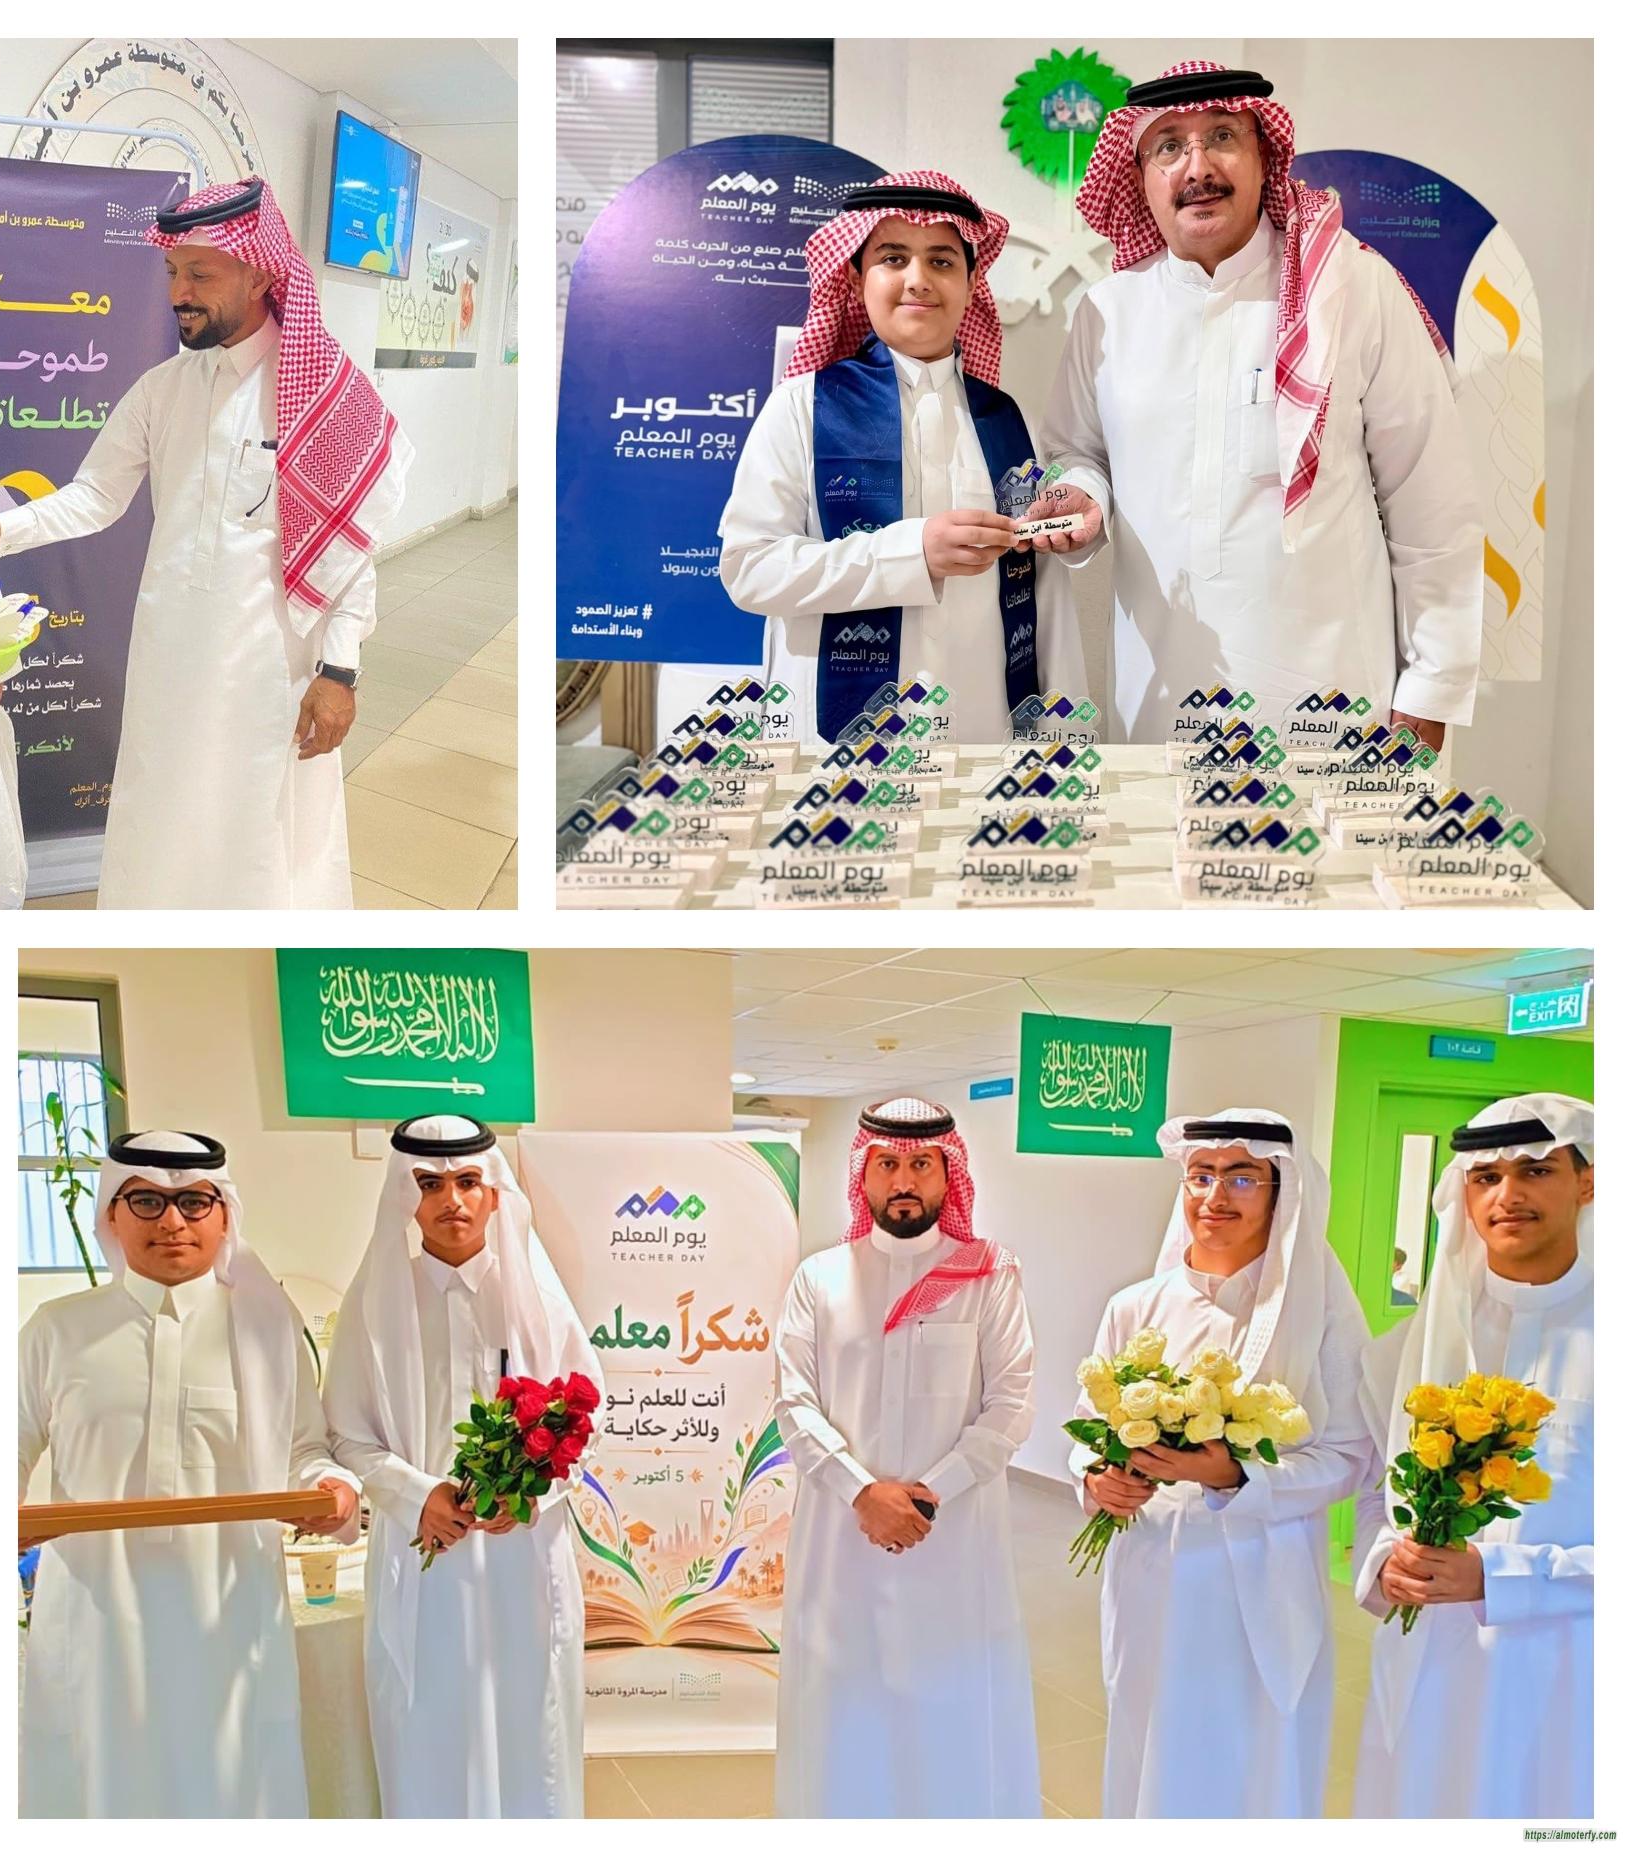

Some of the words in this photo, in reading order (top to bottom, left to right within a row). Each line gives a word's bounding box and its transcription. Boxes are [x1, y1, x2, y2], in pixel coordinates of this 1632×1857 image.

[128, 42, 186, 75] متوسطة
[84, 51, 123, 89] عمرو
[62, 80, 82, 114] بن
[700, 196, 747, 211] المعلم
[749, 203, 776, 216] يوم
[790, 205, 837, 217] التعليم
[9, 212, 21, 227] بن
[22, 216, 42, 227] عمرو
[44, 214, 85, 230] متوسطة
[700, 213, 751, 223] TEACHER
[756, 217, 774, 225] DAY
[1360, 216, 1410, 226] التعليم
[1412, 217, 1440, 228] وزارة
[104, 228, 137, 237] التعليم
[691, 241, 728, 253] الحرف
[730, 244, 751, 254] من
[753, 246, 782, 257] صنع
[652, 253, 695, 265] الحياة
[698, 257, 736, 269] ومن
[609, 388, 758, 422] أكتوبر
[616, 426, 691, 446] المعلم
[696, 431, 736, 449] يوم
[613, 446, 695, 460] TEACHER
[702, 449, 737, 461] DAY
[824, 489, 845, 498] المعلم
[1000, 489, 1042, 510] المعلم
[1045, 487, 1069, 502] يوم
[1030, 524, 1042, 535] ابن
[1044, 519, 1073, 530] متوسطة
[661, 562, 698, 576] رسولا
[575, 603, 612, 616] الصمود
[613, 605, 639, 617] تعزيز
[48, 609, 85, 628] بتاريخ
[620, 624, 643, 639] وبناء
[23, 655, 49, 669] لكل
[829, 648, 866, 662] المعلم
[869, 652, 890, 664] يوم
[11, 678, 42, 693] ثمارها
[12, 702, 23, 713] له
[25, 702, 39, 716] من
[41, 700, 68, 714] لكل
[760, 714, 789, 728] يوم
[1288, 719, 1338, 734] المعلم
[1012, 728, 1062, 742] المعلم
[1066, 733, 1095, 749] يوم
[24, 734, 75, 756] لأنكم
[1296, 764, 1315, 775] سينا
[1343, 777, 1400, 795] المعلم
[1403, 780, 1435, 798] يوم
[673, 816, 711, 834] يوم
[1355, 833, 1376, 845] سينا
[631, 850, 671, 869] يوم
[1417, 855, 1487, 877] المعلم
[760, 860, 835, 884] المعلم
[842, 865, 884, 887] يوم
[959, 858, 1032, 881] المعلم
[1040, 864, 1079, 880] يوم
[1198, 858, 1271, 881] المعلم
[1492, 863, 1532, 883] يوم
[643, 876, 670, 885] DAY
[1275, 869, 1315, 893] يوم
[961, 889, 1039, 898] TEACHER
[1048, 889, 1076, 898] DAY
[1418, 885, 1492, 895] TEACHER
[1502, 889, 1528, 898] DAY
[1528, 1011, 1556, 1023] EXIT
[609, 1225, 668, 1247] المعلم
[672, 1233, 706, 1249] يوم
[611, 1252, 674, 1262] TEACHER
[680, 1253, 705, 1263] DAY
[589, 1304, 672, 1350] معلم
[675, 1290, 771, 1366] شكراً
[638, 1387, 687, 1413] للعلم
[691, 1382, 727, 1407] أنت
[603, 1417, 667, 1442] حكاية
[671, 1417, 720, 1442] وللأثر
[632, 1465, 671, 1486] أكتوبر
[675, 1470, 684, 1482] 5
[585, 1686, 616, 1698] الثانوية
[640, 1686, 668, 1698] مدرسة
